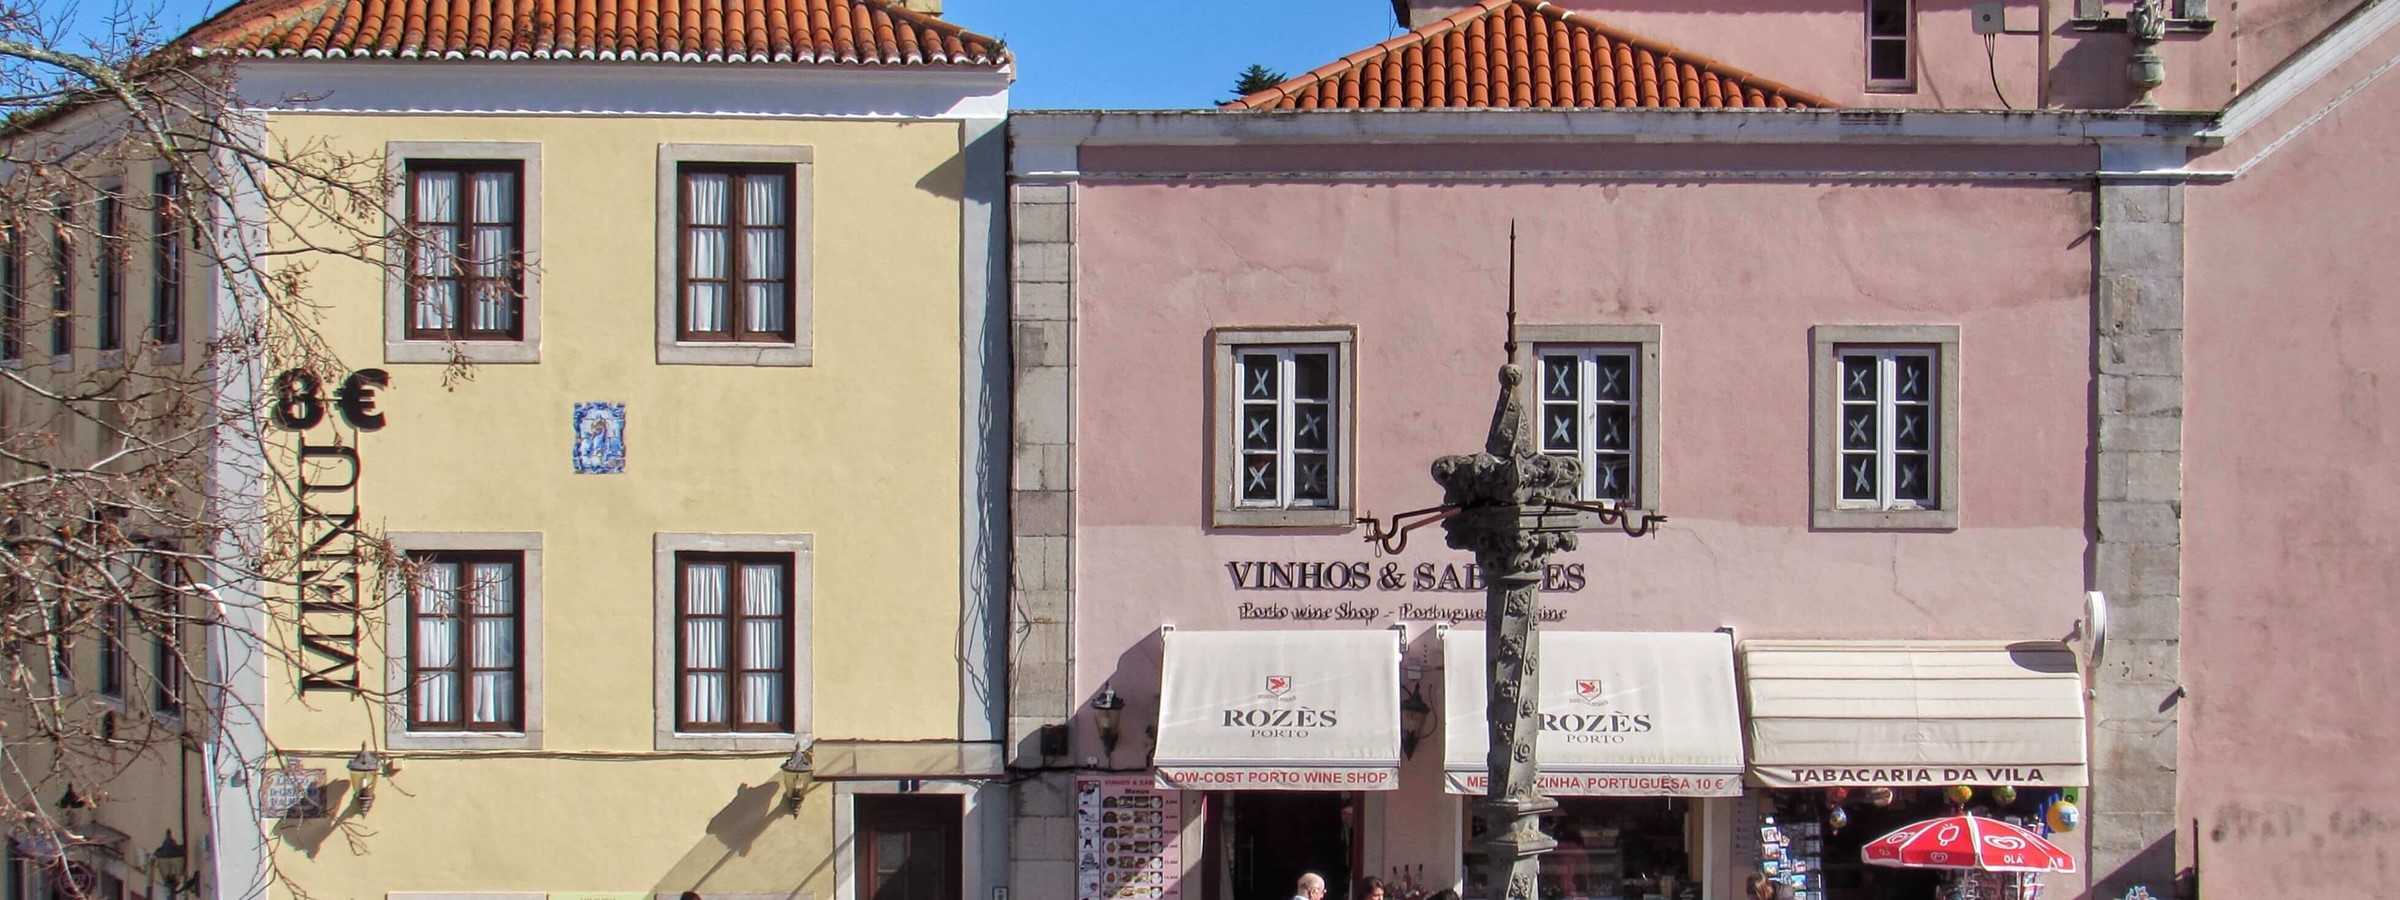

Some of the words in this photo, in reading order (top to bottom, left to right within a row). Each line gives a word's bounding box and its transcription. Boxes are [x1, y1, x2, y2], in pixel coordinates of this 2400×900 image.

[299, 439, 361, 698] MENU
[1225, 561, 1371, 590] VINHOS
[1377, 561, 1407, 591] &
[1413, 562, 1587, 592] SABES
[1240, 602, 1288, 619] Porto
[1291, 604, 1332, 620] wine
[1335, 601, 1379, 626] Shop
[1222, 706, 1338, 727] ROZÈS
[1537, 711, 1652, 732] ROZÈS
[1251, 729, 1309, 738] PORTO
[1567, 735, 1625, 744] PORTO
[1165, 771, 1244, 783] LOW-COST
[1249, 772, 1299, 783] PORTO
[1304, 772, 1342, 783] WINE
[1346, 772, 1388, 783] SHOP
[1791, 769, 1932, 782] TABACARIA
[1943, 768, 1978, 782] DA
[1986, 768, 2045, 782] VILA
[1537, 777, 1580, 789] ZINHA
[1696, 778, 1711, 790] 10
[1715, 778, 1724, 790] €
[2003, 853, 2025, 864] OLÁ
